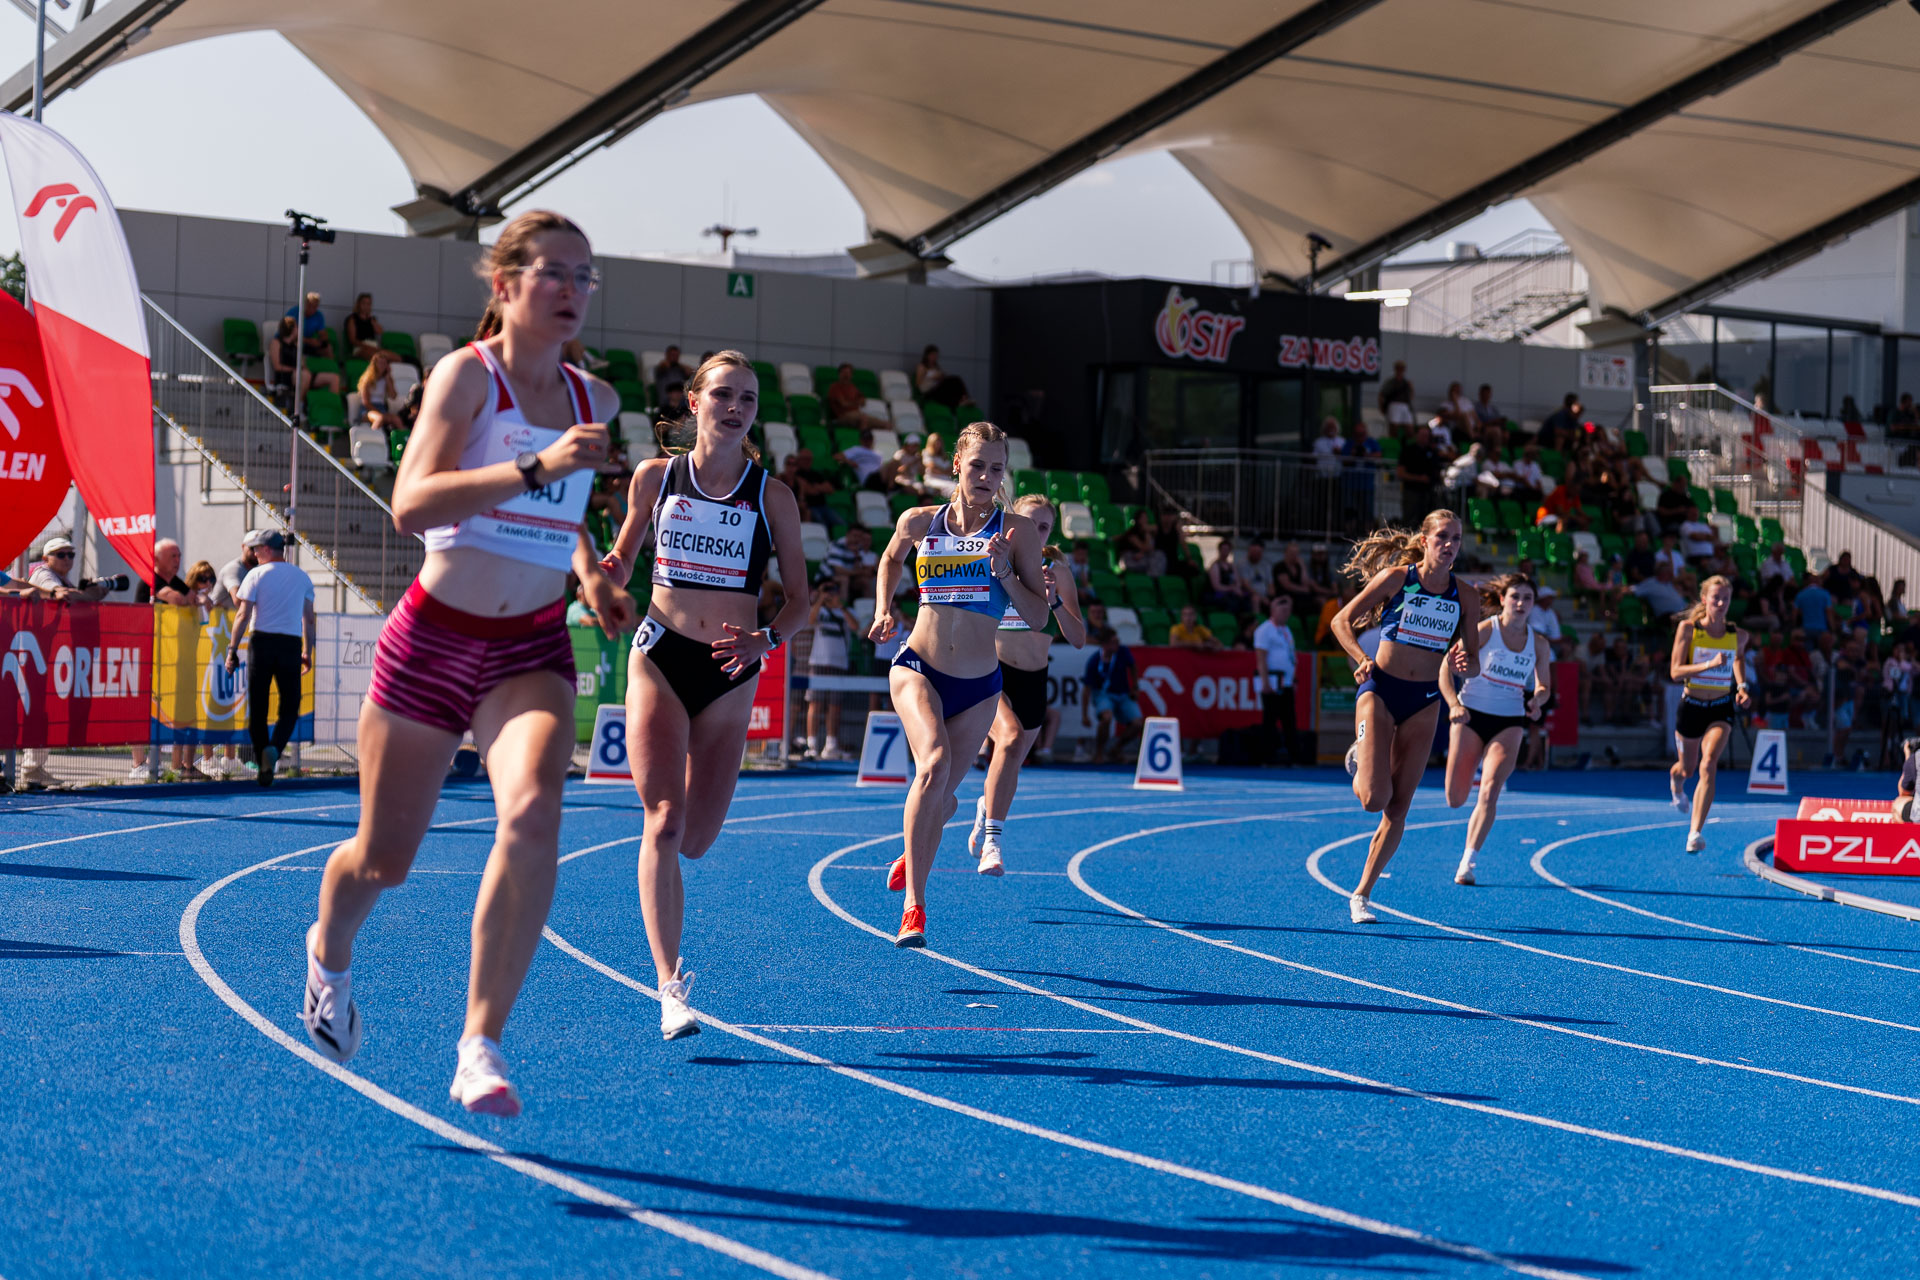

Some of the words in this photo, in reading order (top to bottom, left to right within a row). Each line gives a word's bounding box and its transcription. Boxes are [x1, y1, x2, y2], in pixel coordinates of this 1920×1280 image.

[733, 275, 749, 295] A
[1279, 334, 1379, 375] ZAMOŚĆ
[670, 513, 693, 522] ORLEN
[719, 510, 741, 526] 10
[660, 529, 746, 559] CIECIERSKA
[956, 541, 984, 552] 339
[668, 568, 704, 581] ZAMOŚĆ
[705, 575, 726, 584] 2026
[918, 563, 986, 578] OLCHAWA
[928, 593, 956, 601] ZAMOŚĆ
[1435, 601, 1456, 614] 230
[1403, 612, 1454, 633] ŁUKOWSKA
[637, 622, 656, 648] 6
[1486, 661, 1528, 681] JAROMIN
[1513, 655, 1531, 667] 527
[53, 645, 140, 699] ORLEN
[599, 721, 627, 766] 8
[872, 727, 900, 770] 7
[1146, 733, 1173, 773] 6
[1757, 743, 1780, 780] 4
